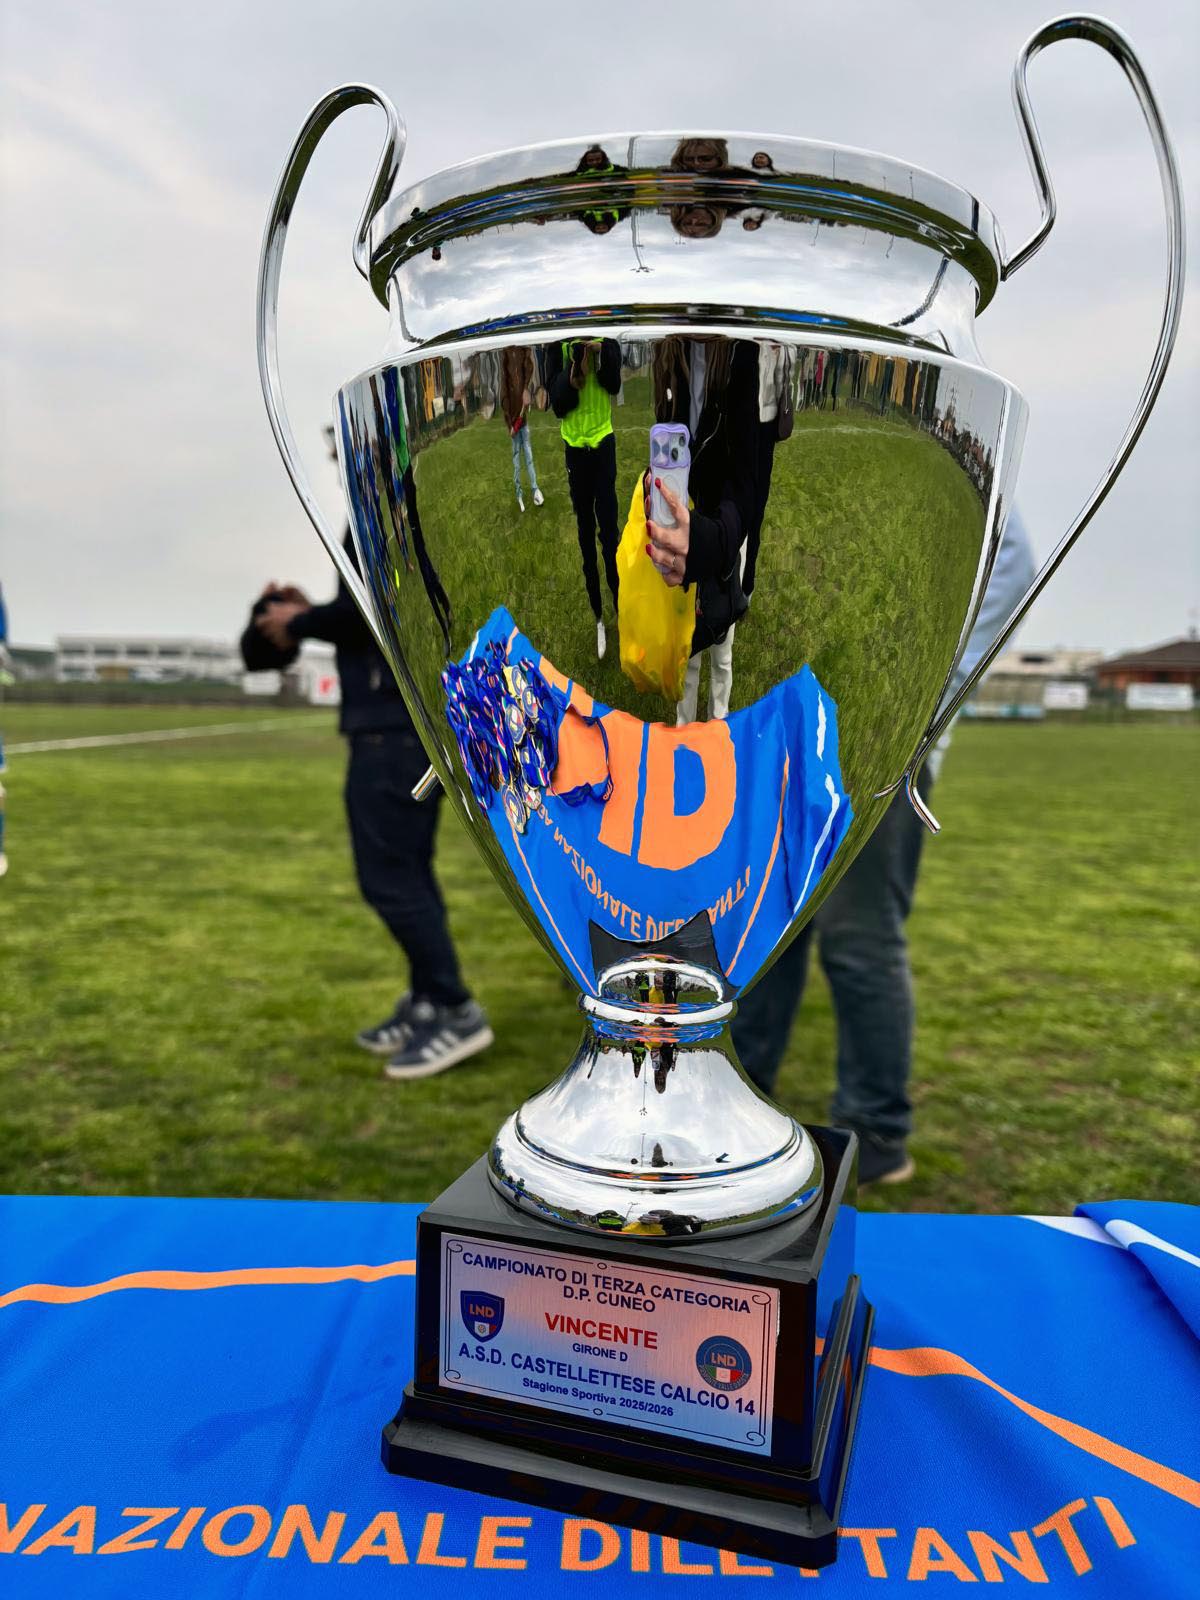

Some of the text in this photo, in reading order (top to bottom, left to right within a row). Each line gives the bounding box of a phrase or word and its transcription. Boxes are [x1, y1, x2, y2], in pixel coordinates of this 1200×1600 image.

[463, 1252, 751, 1314] CAMPIONATO DI TERZA CATEGORIA
[564, 1285, 656, 1313] D.P. CUNEO
[468, 1303, 496, 1319] LND
[545, 1312, 659, 1350] VINCENTE
[572, 1343, 629, 1363] GIRONE D
[711, 1352, 737, 1367] LND
[459, 1343, 756, 1416] A.S.D. CASTELLETTESE CALCIO 14
[523, 1378, 674, 1417] Stagione Sportiva 2025/2026
[560, 1496, 1137, 1583] DILTANTI
